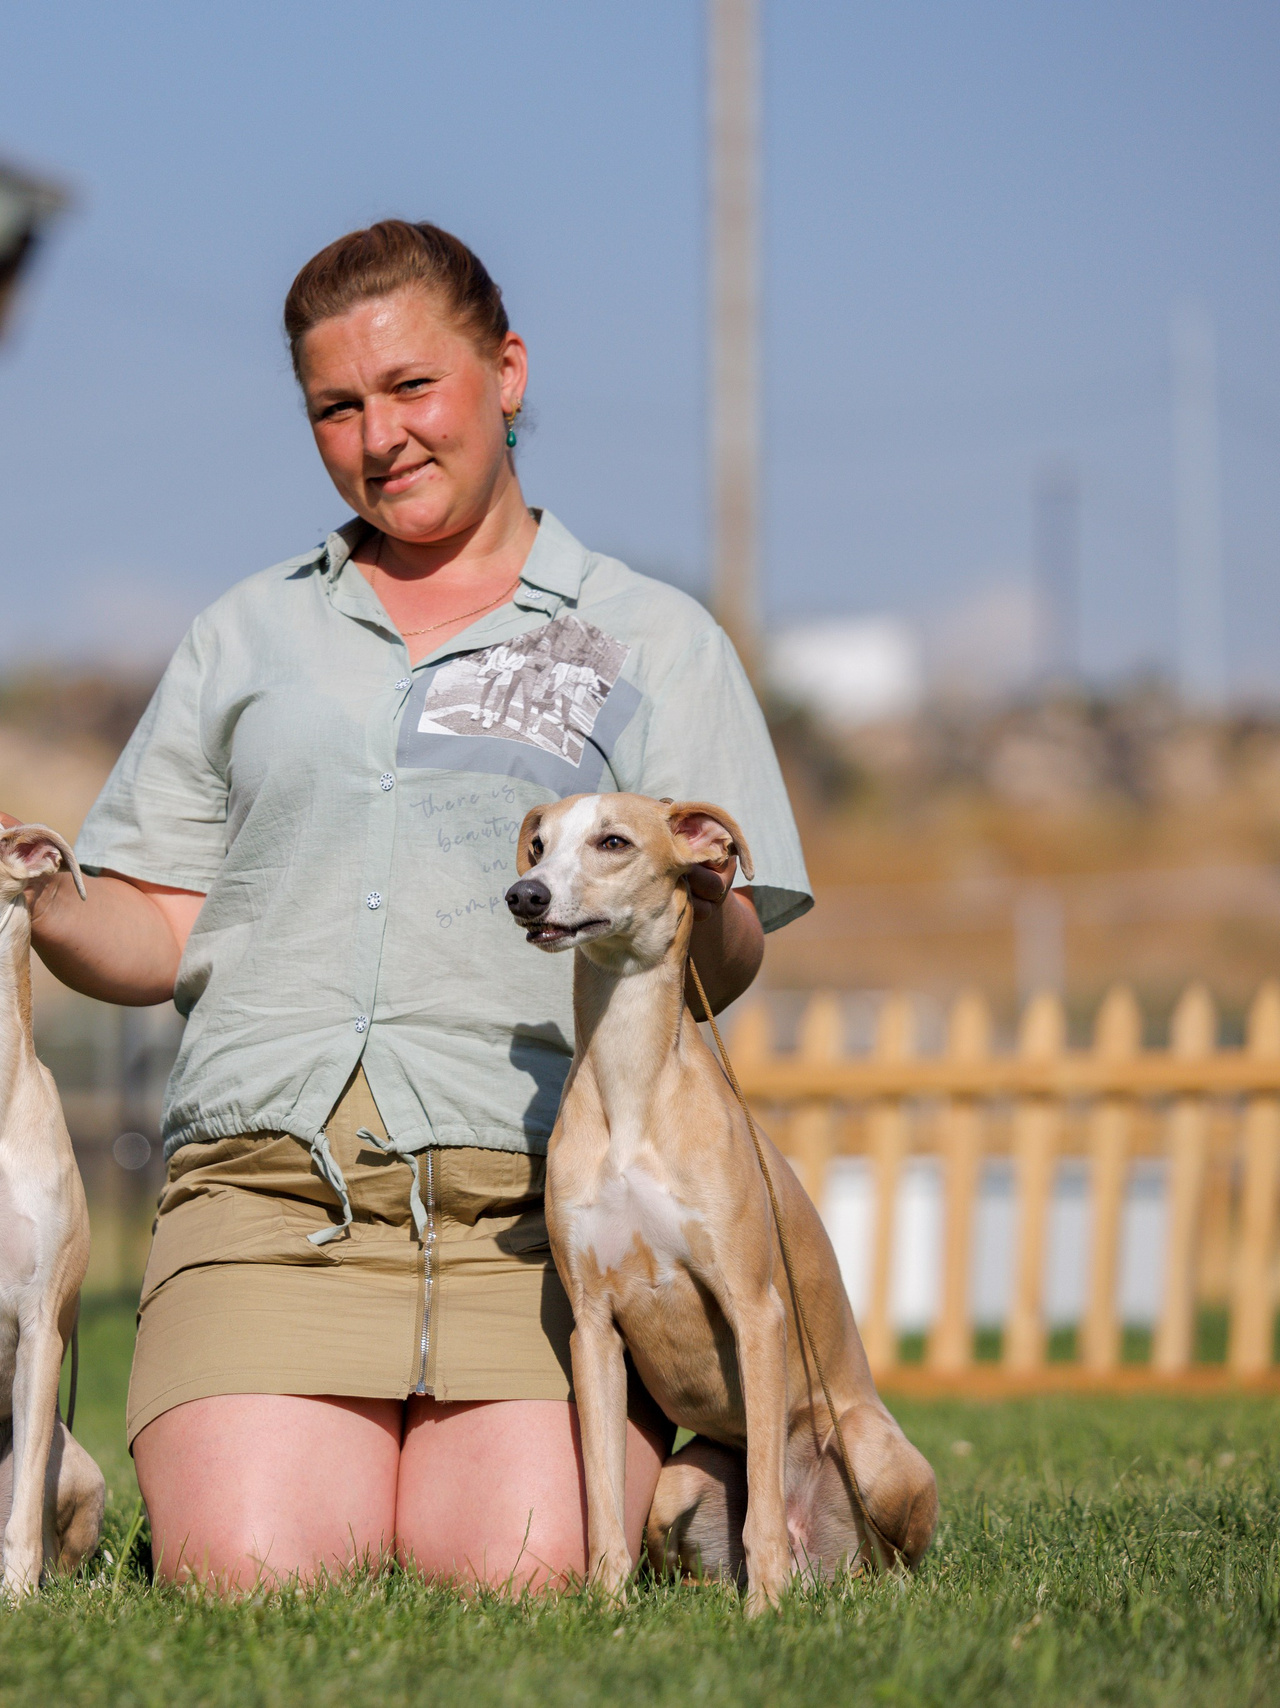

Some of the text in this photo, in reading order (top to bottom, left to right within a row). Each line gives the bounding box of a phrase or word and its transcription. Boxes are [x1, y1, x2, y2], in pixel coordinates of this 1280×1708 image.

[410, 784, 516, 819] there is
[437, 816, 520, 853] beauty
[482, 859, 508, 873] in
